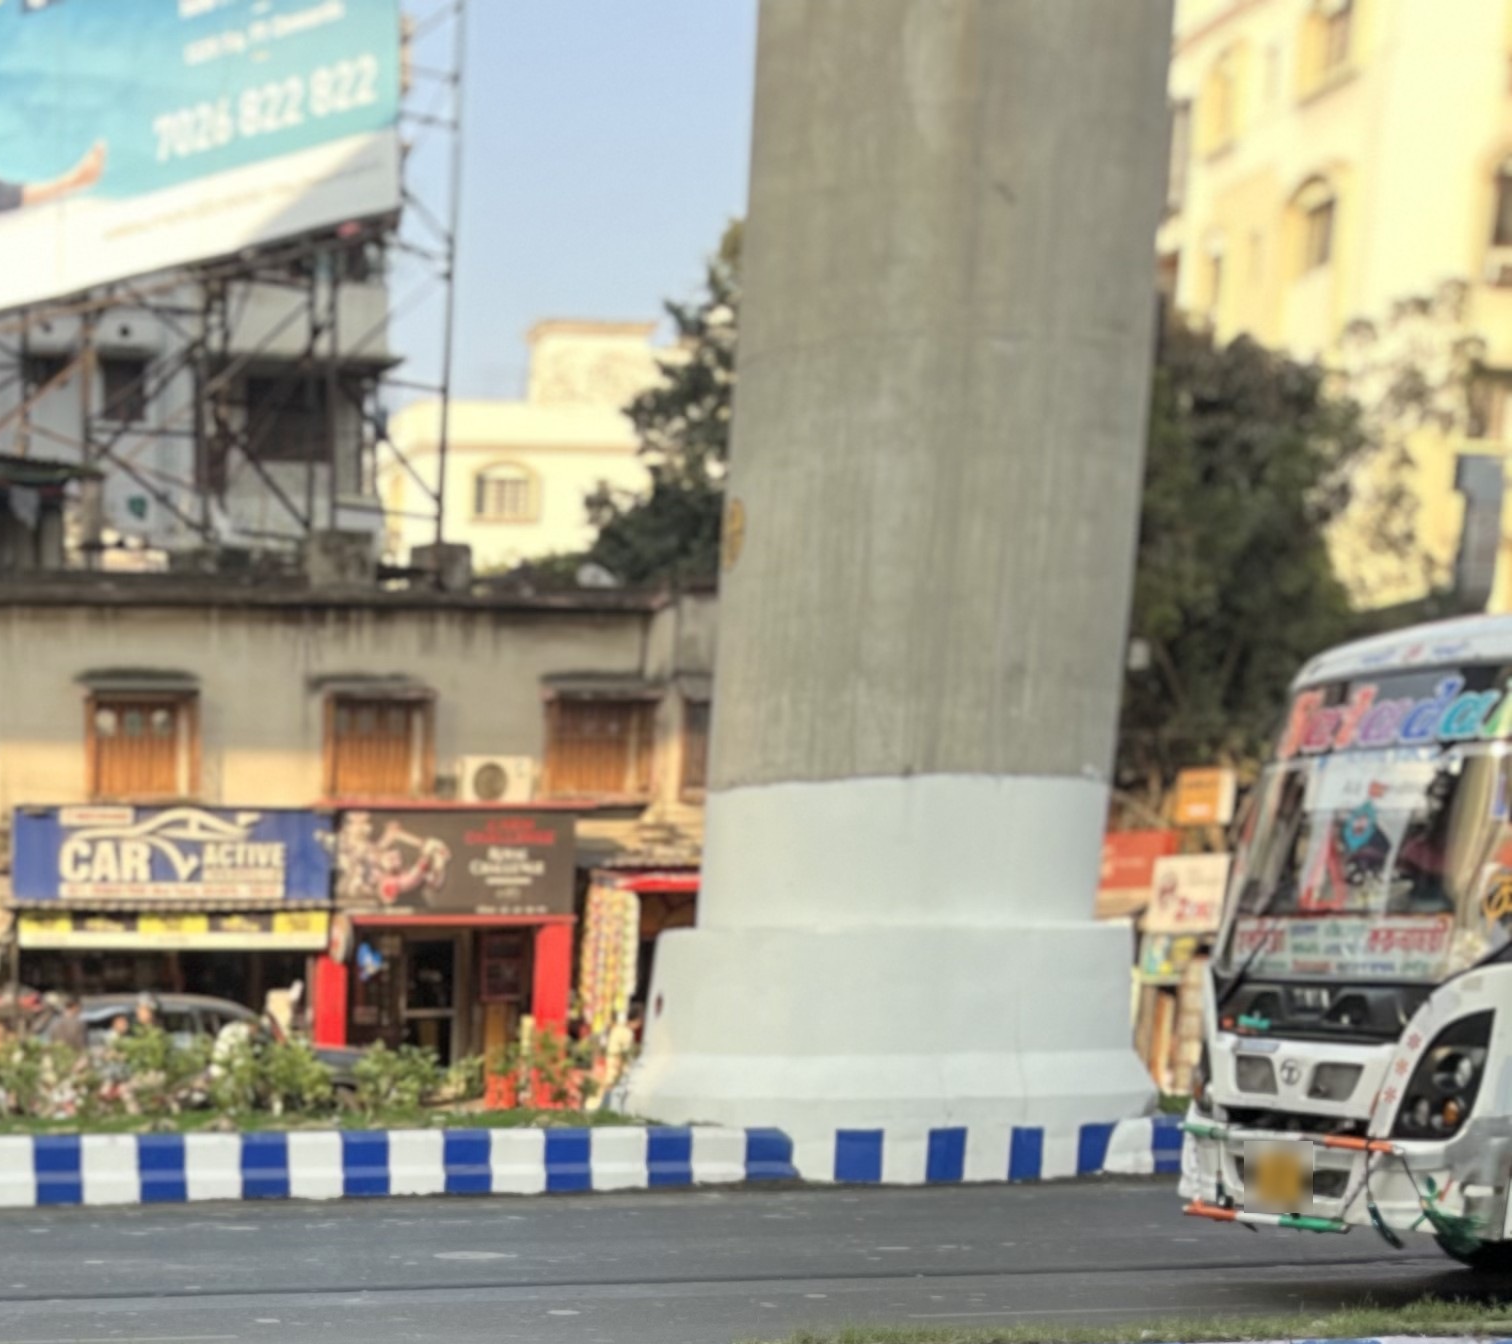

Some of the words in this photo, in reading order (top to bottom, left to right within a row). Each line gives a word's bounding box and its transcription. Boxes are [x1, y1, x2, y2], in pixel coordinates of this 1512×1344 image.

[237, 73, 306, 138] 822
[308, 52, 380, 118] 822
[59, 838, 152, 883] CAR
[202, 842, 285, 868] ACTIVE
